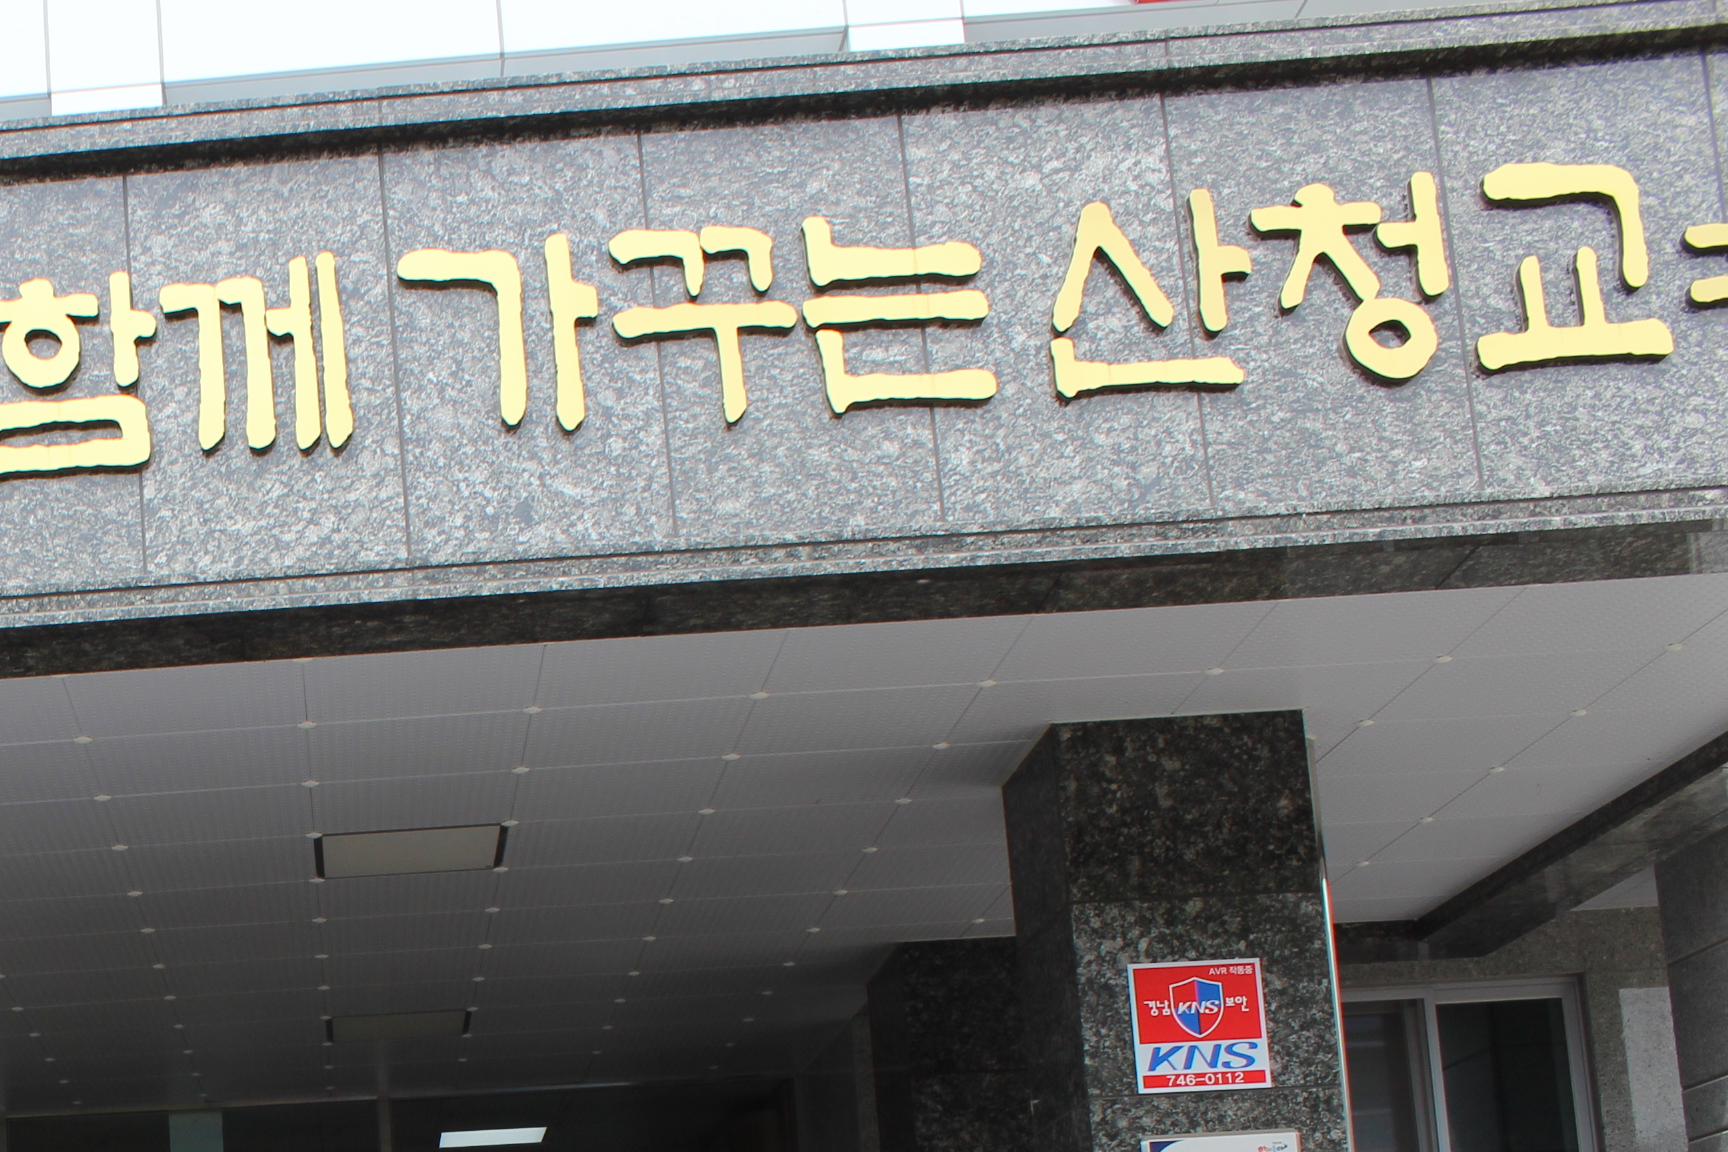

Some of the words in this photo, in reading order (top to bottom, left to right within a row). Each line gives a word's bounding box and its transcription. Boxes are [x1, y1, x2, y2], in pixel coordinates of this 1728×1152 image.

[398, 215, 997, 430] 가꾸는
[1051, 161, 1728, 399] 산청교
[1209, 967, 1227, 975] AVR
[1143, 1000, 1171, 1016] 경남
[1177, 1000, 1221, 1014] KNS
[1225, 996, 1250, 1012] 보안
[1148, 1041, 1258, 1071] KNS
[1166, 1072, 1245, 1086] 746-0112
